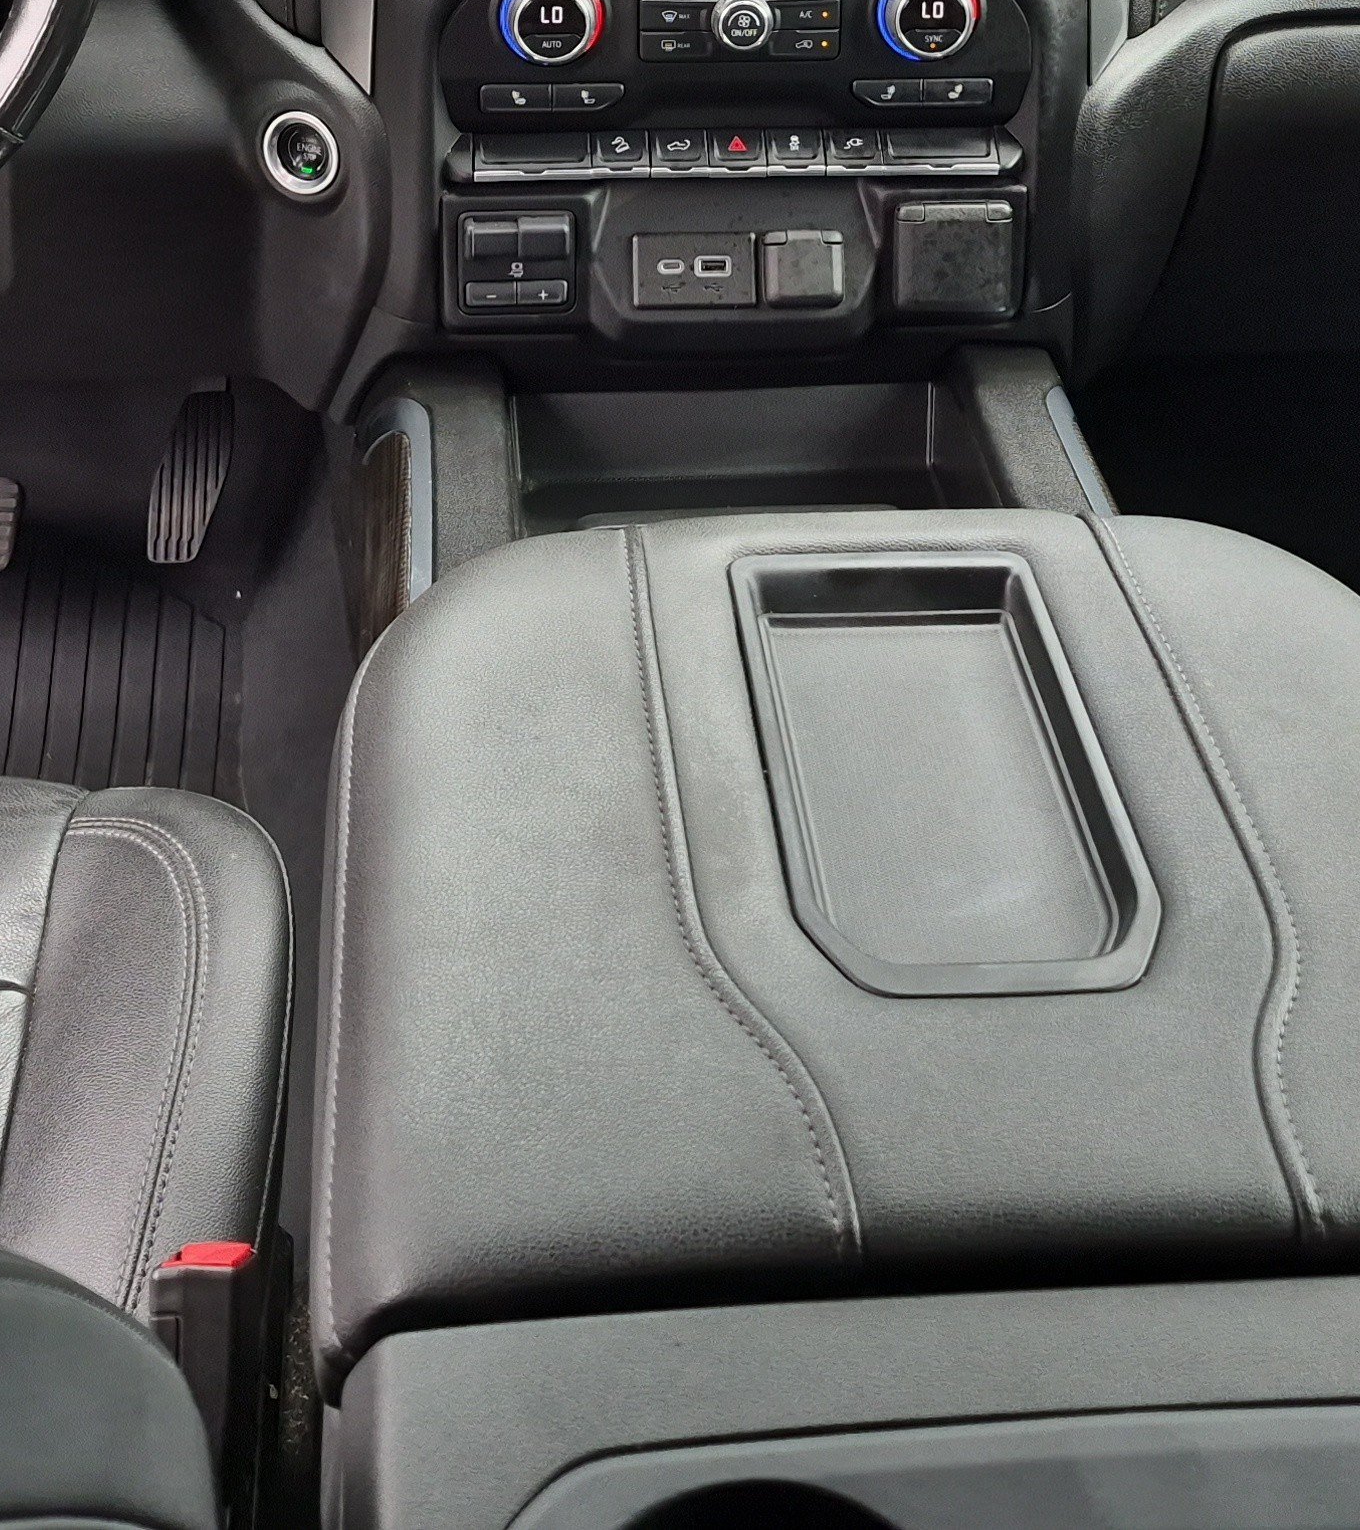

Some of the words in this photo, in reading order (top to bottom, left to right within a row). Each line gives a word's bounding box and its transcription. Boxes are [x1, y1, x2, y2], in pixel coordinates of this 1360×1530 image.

[921, 1, 944, 19] LO
[540, 6, 563, 24] LO
[799, 11, 813, 19] A/C
[731, 28, 758, 37] ON/OFF
[925, 35, 943, 43] SYNC
